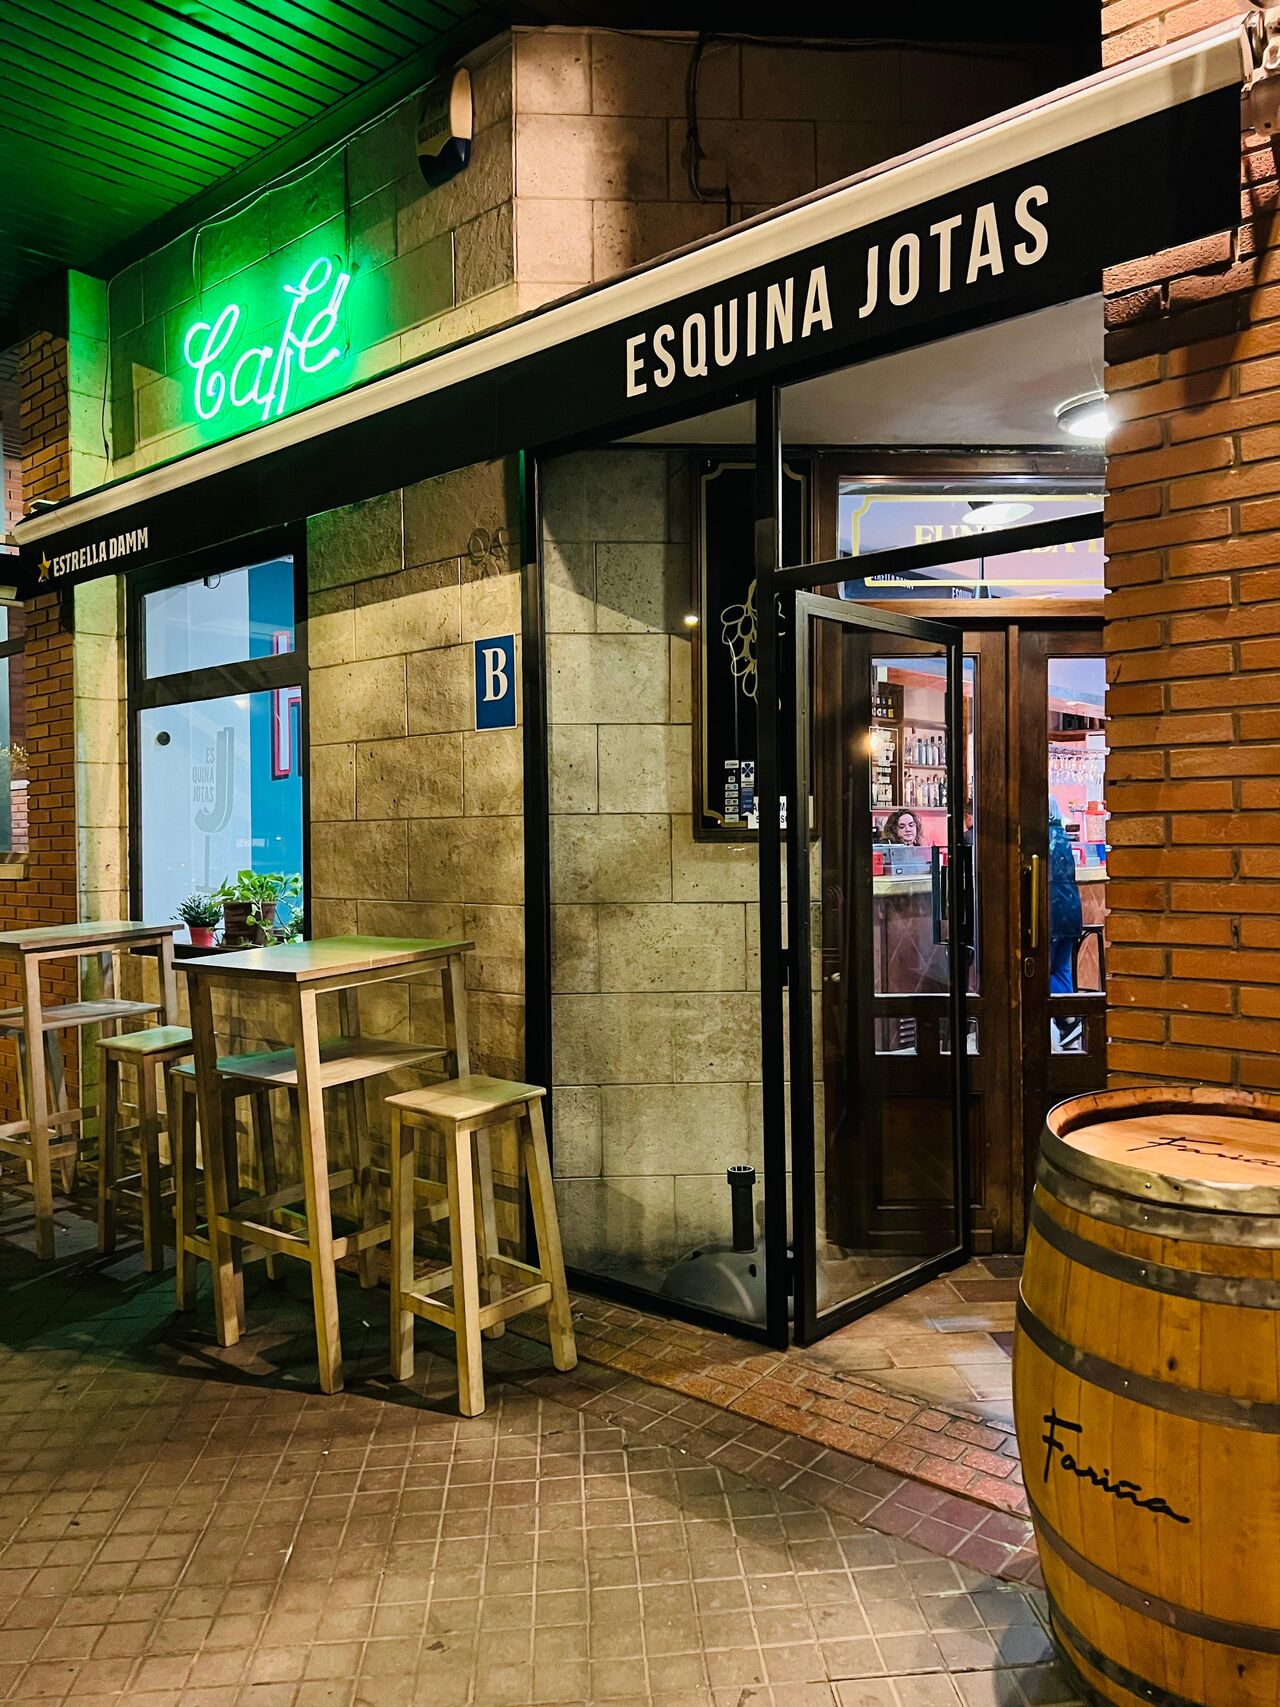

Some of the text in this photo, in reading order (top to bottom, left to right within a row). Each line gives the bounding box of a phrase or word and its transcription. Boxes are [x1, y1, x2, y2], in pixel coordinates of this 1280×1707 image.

[626, 185, 1049, 398] ESQUINA JOTAS
[184, 257, 350, 421] Café
[53, 527, 149, 577] ESTRELLA DAMM
[482, 647, 508, 702] B
[192, 766, 214, 785] QUINA
[206, 747, 215, 764] ES
[193, 785, 214, 803] JOTAS
